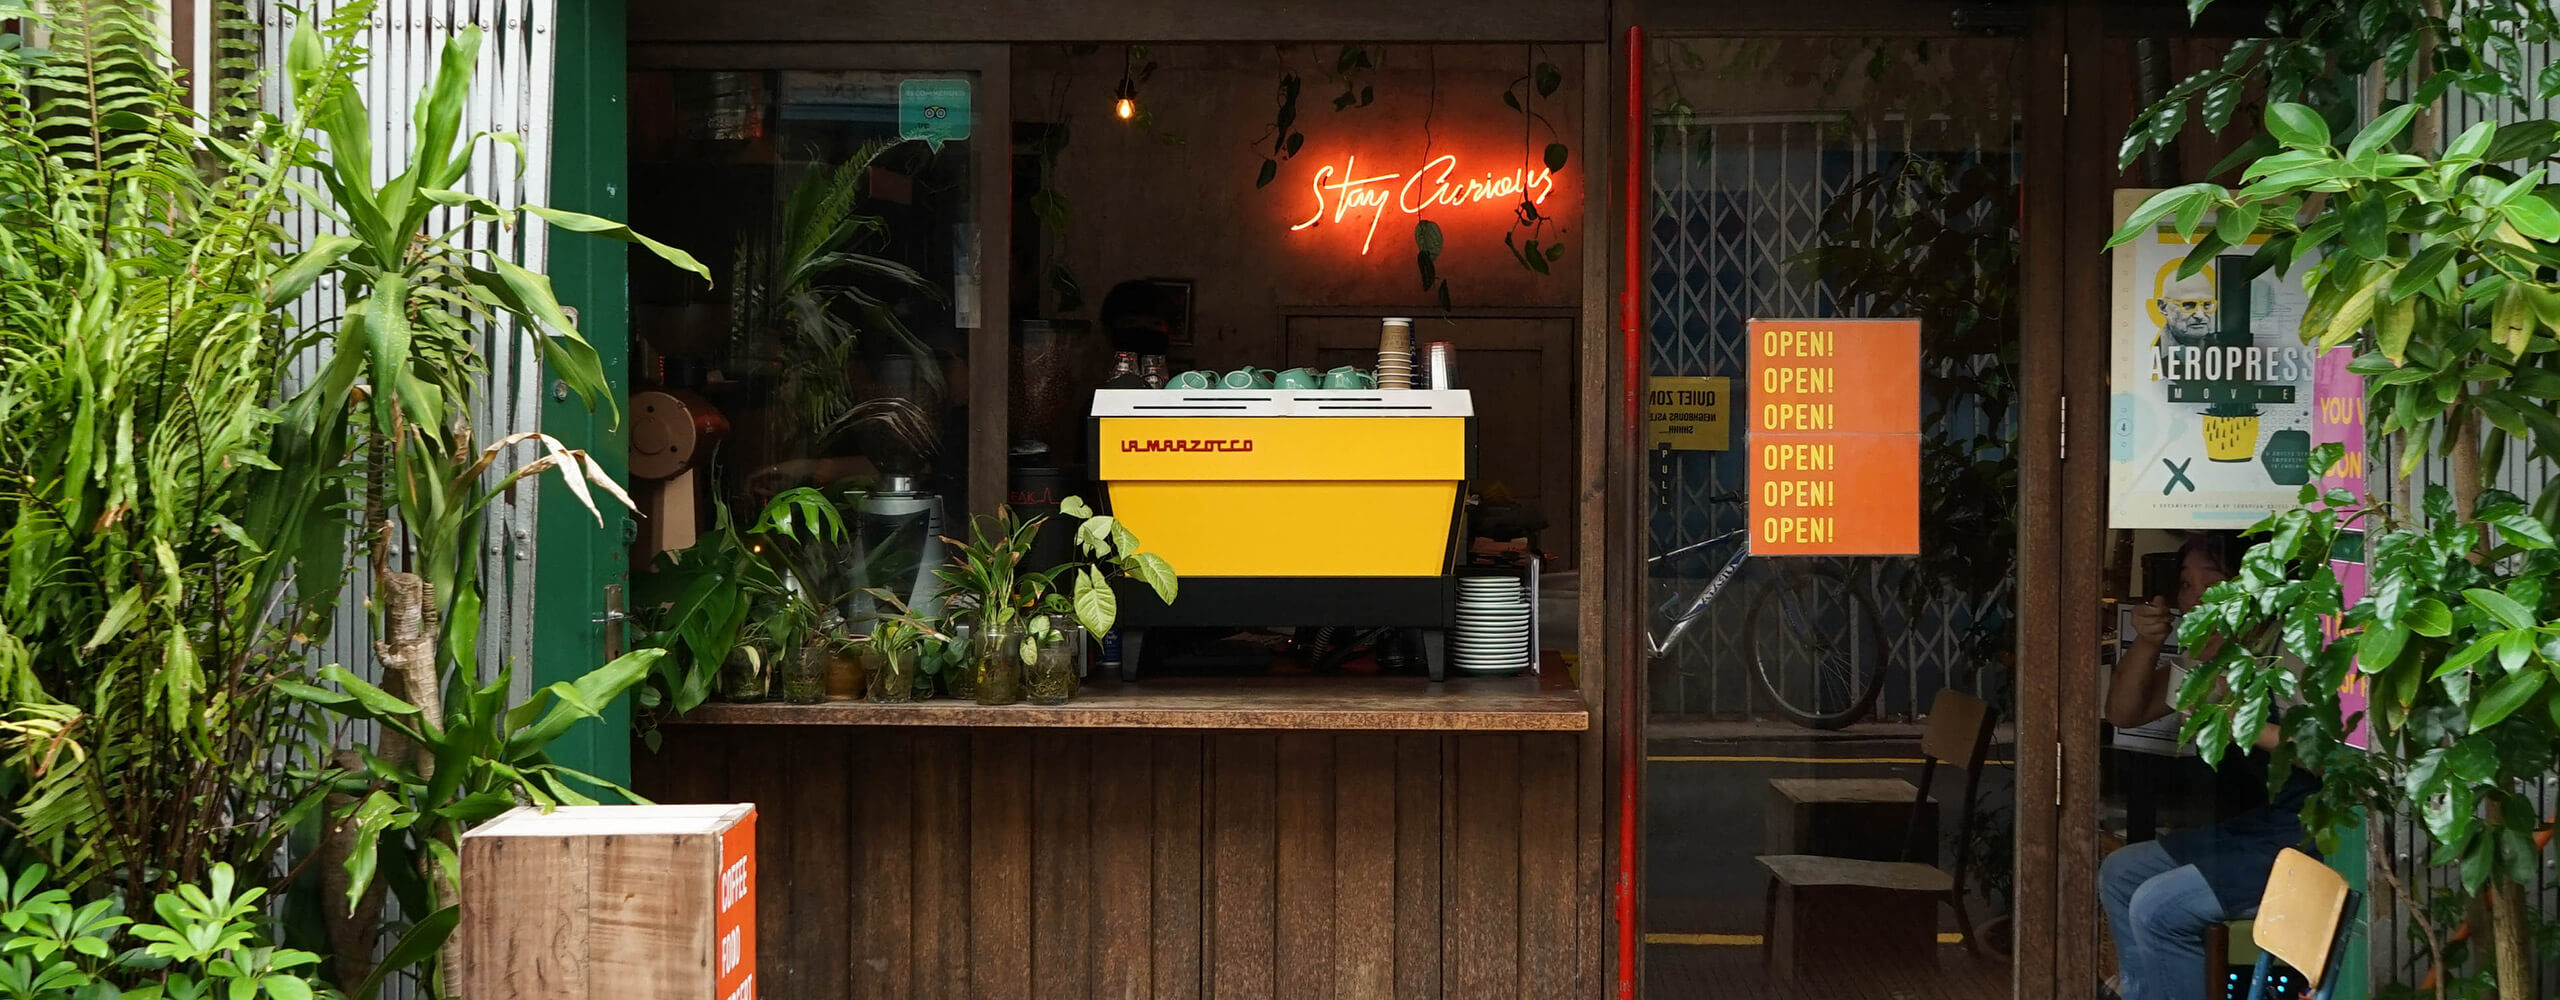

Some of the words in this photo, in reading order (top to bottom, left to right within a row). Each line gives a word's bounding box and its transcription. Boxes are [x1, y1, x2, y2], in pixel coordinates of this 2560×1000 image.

[1291, 155, 1400, 255] Stay
[1400, 154, 1554, 213] Curious
[1763, 331, 1834, 357] OPEN!
[2151, 346, 2312, 381] AEROPRESS
[1763, 367, 1834, 394] OPEN!
[2174, 388, 2289, 399] MOVIE
[1763, 404, 1834, 430] OPEN!
[2320, 397, 2353, 425] YOU
[1121, 440, 1138, 452] LA
[1146, 440, 1253, 452] MARZOCCO
[1763, 444, 1834, 471] OPEN!
[1763, 480, 1834, 507] OPEN!
[1763, 517, 1834, 543] OPEN!
[721, 855, 748, 914] COFFEE
[721, 924, 741, 979] FOOD
